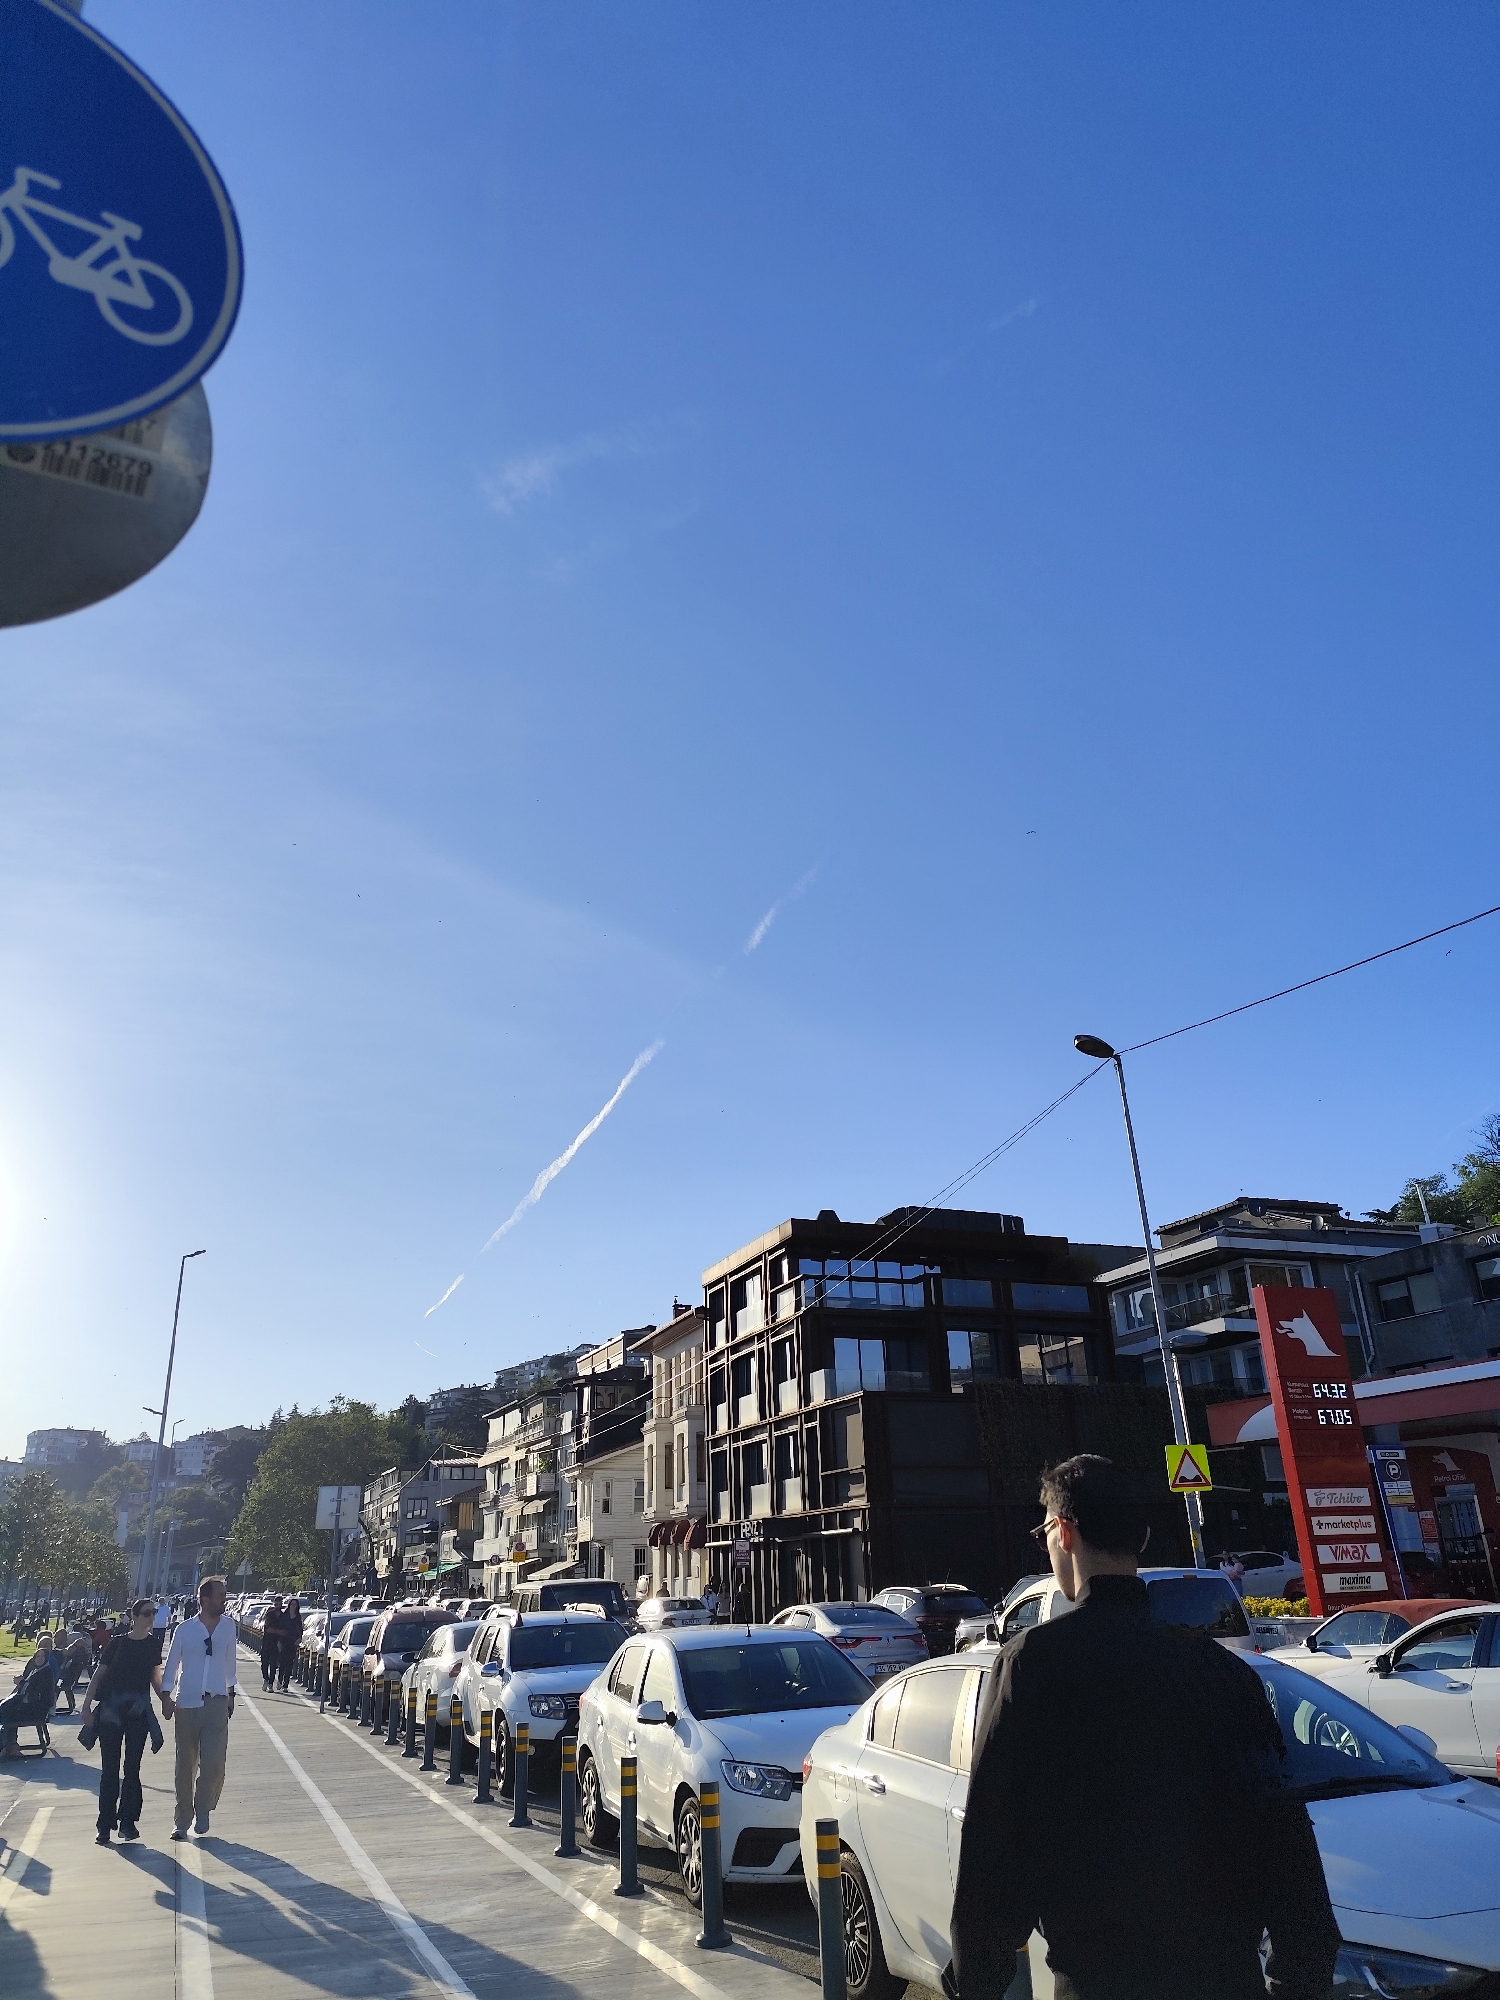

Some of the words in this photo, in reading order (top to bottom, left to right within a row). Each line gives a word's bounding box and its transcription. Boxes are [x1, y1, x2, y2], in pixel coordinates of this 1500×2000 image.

[1312, 1383, 1347, 1398] 64.32
[1317, 1409, 1352, 1425] 67.05
[1327, 1491, 1365, 1504] Tchibo
[1340, 1574, 1371, 1585] maxima
